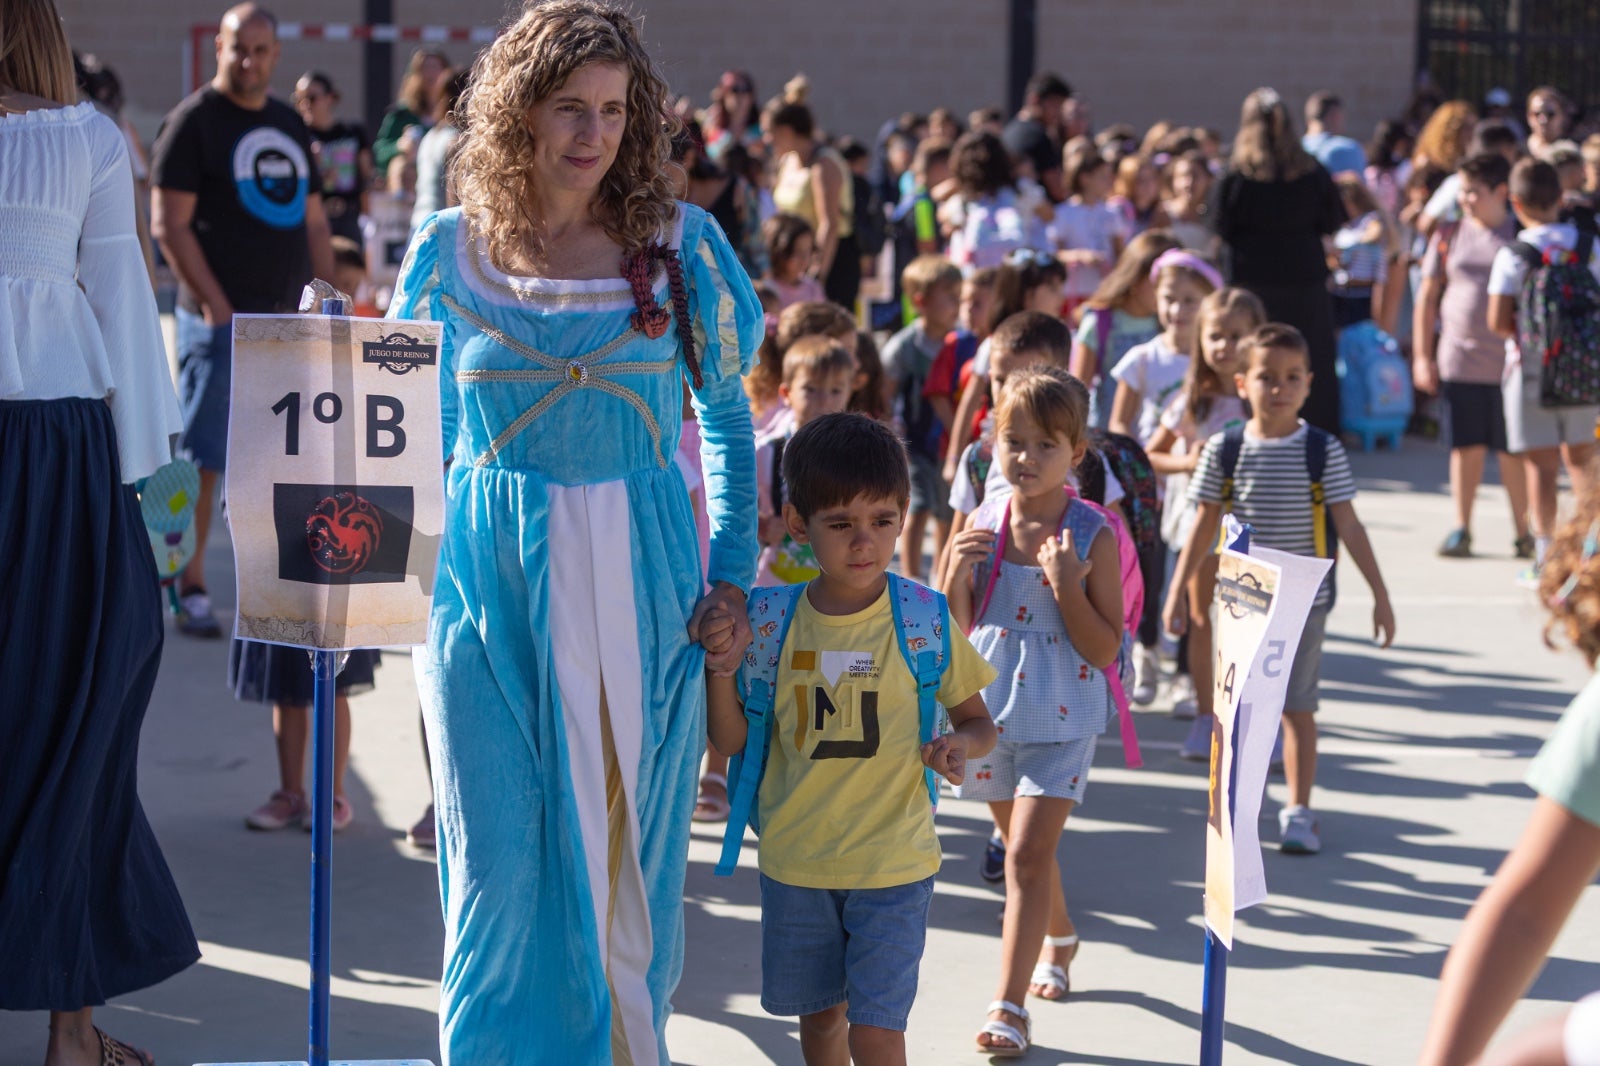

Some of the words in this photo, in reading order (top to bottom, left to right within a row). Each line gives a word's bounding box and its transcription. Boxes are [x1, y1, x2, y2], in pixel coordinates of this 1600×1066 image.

[369, 349, 391, 357] JUEGO
[392, 350, 403, 358] DE
[403, 351, 430, 359] REINOS
[366, 394, 407, 458] B
